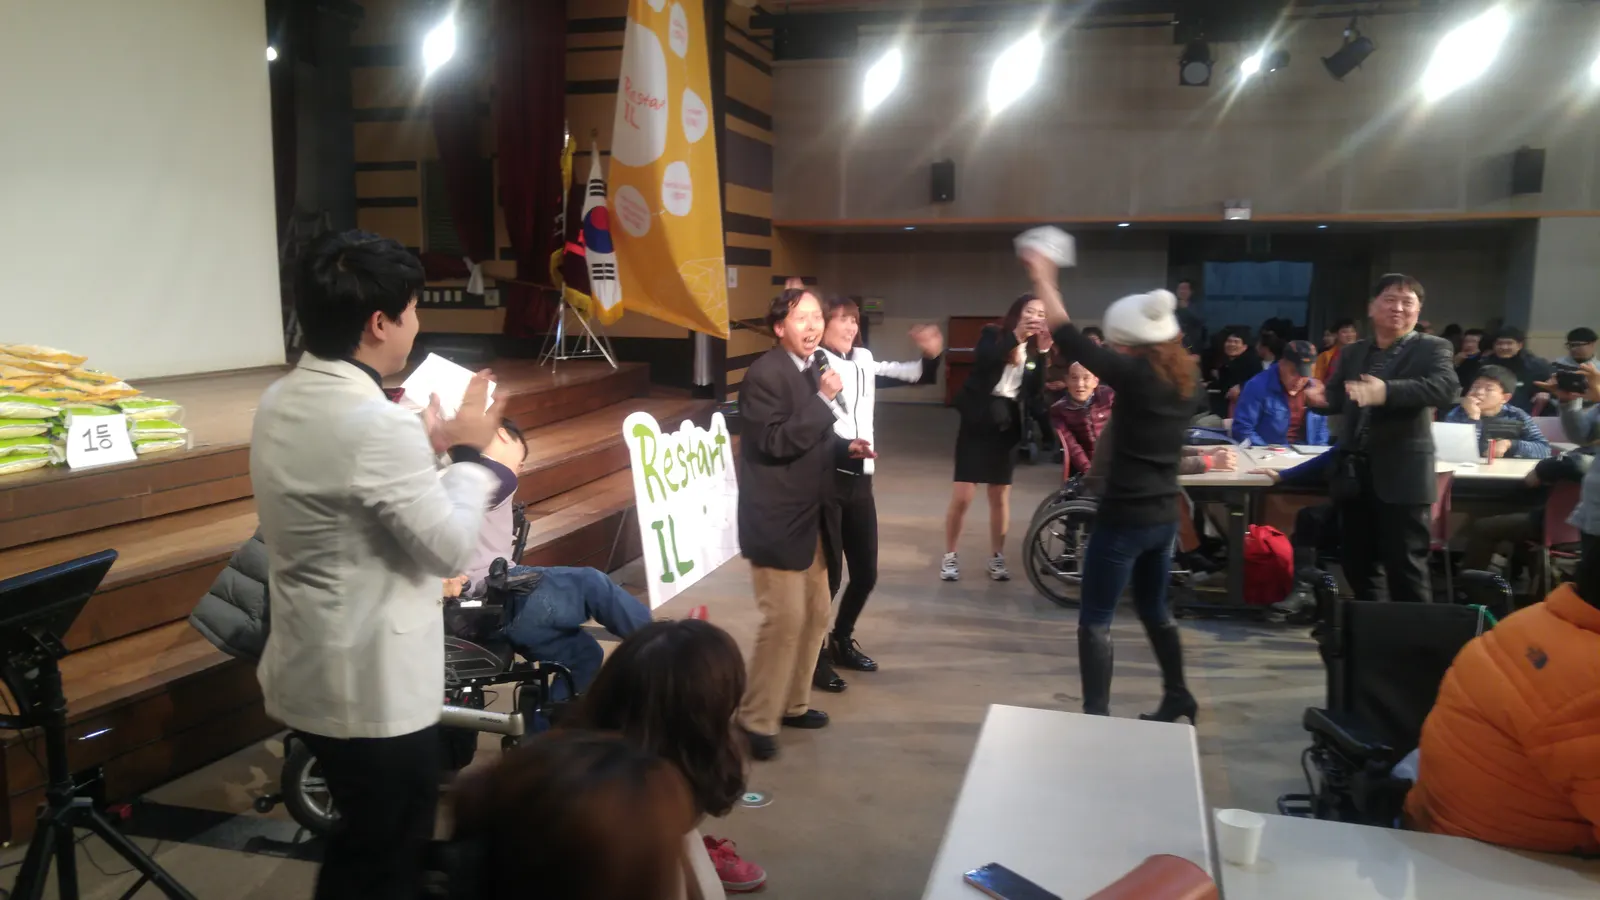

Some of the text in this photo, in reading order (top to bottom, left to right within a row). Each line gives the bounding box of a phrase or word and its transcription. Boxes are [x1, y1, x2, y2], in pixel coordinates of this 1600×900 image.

[624, 100, 640, 130] IL
[82, 423, 114, 453] 1등
[632, 423, 726, 503] Restart
[651, 514, 695, 583] IL
